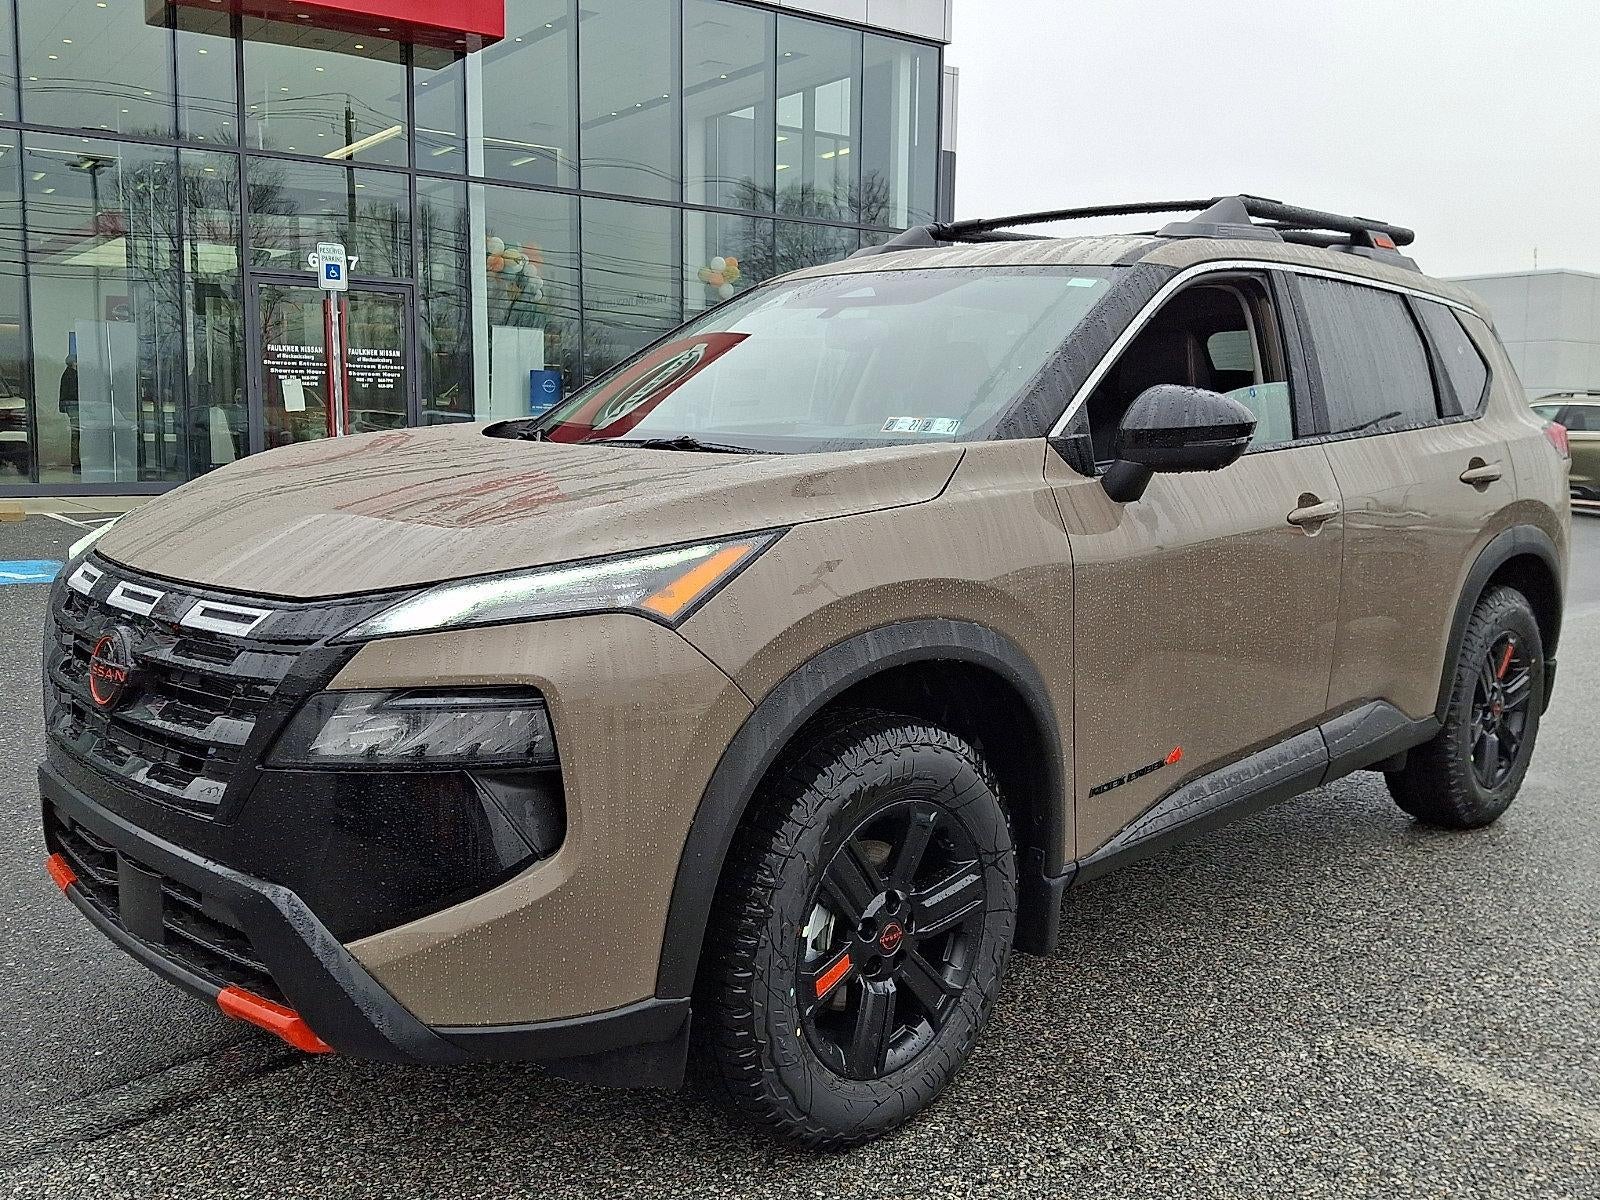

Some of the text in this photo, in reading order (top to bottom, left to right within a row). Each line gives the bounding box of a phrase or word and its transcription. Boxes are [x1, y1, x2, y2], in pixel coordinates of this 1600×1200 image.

[267, 344, 323, 353] FAULKNER NISSAN
[348, 348, 401, 357] FAULKNER NISSAN
